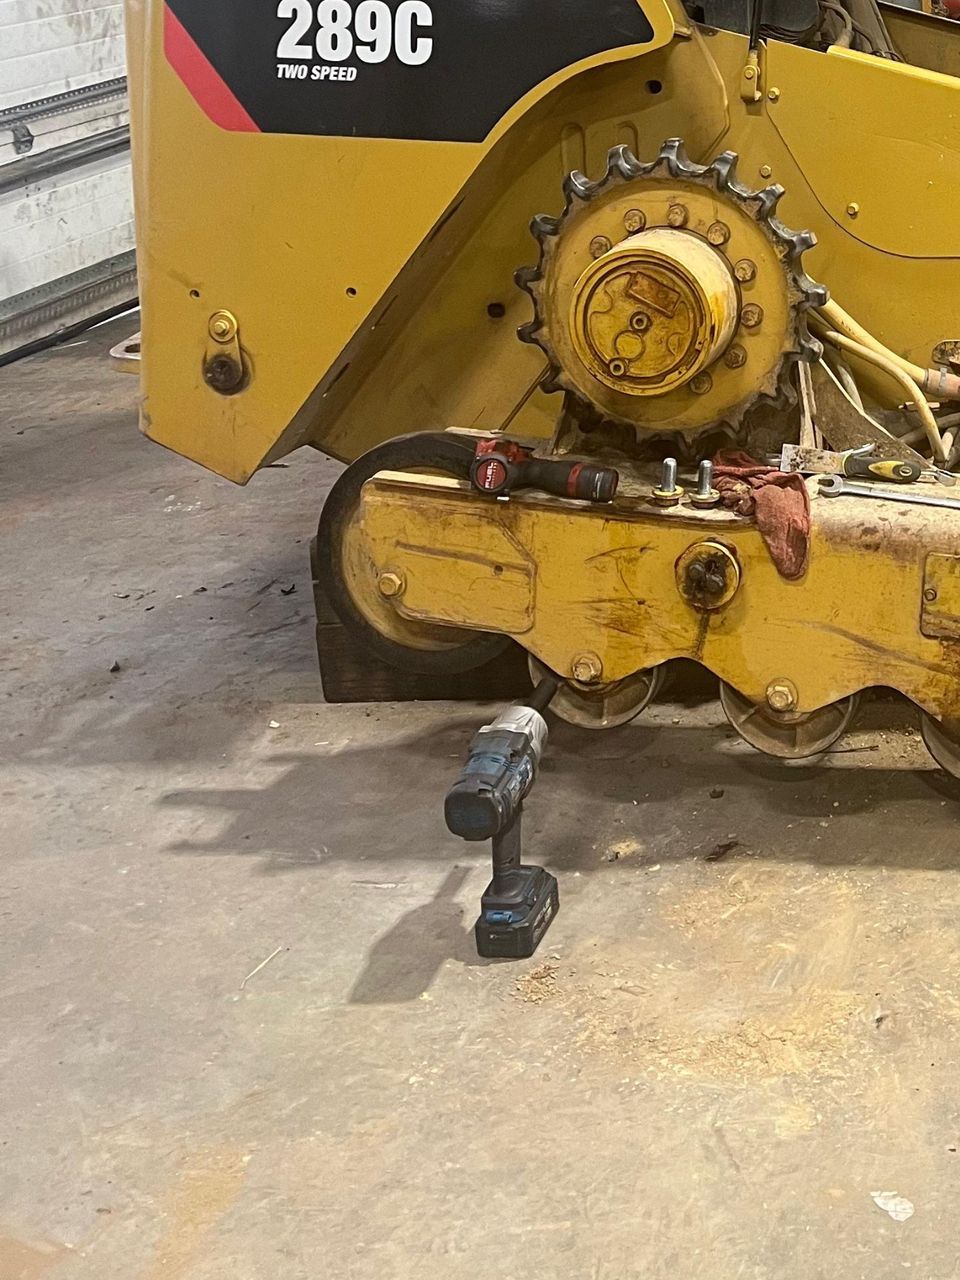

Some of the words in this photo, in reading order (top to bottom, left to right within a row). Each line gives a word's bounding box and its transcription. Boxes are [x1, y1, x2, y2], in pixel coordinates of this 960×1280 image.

[276, 64, 308, 80] TWO
[310, 65, 358, 82] SPEED
[484, 462, 494, 489] FUEL
